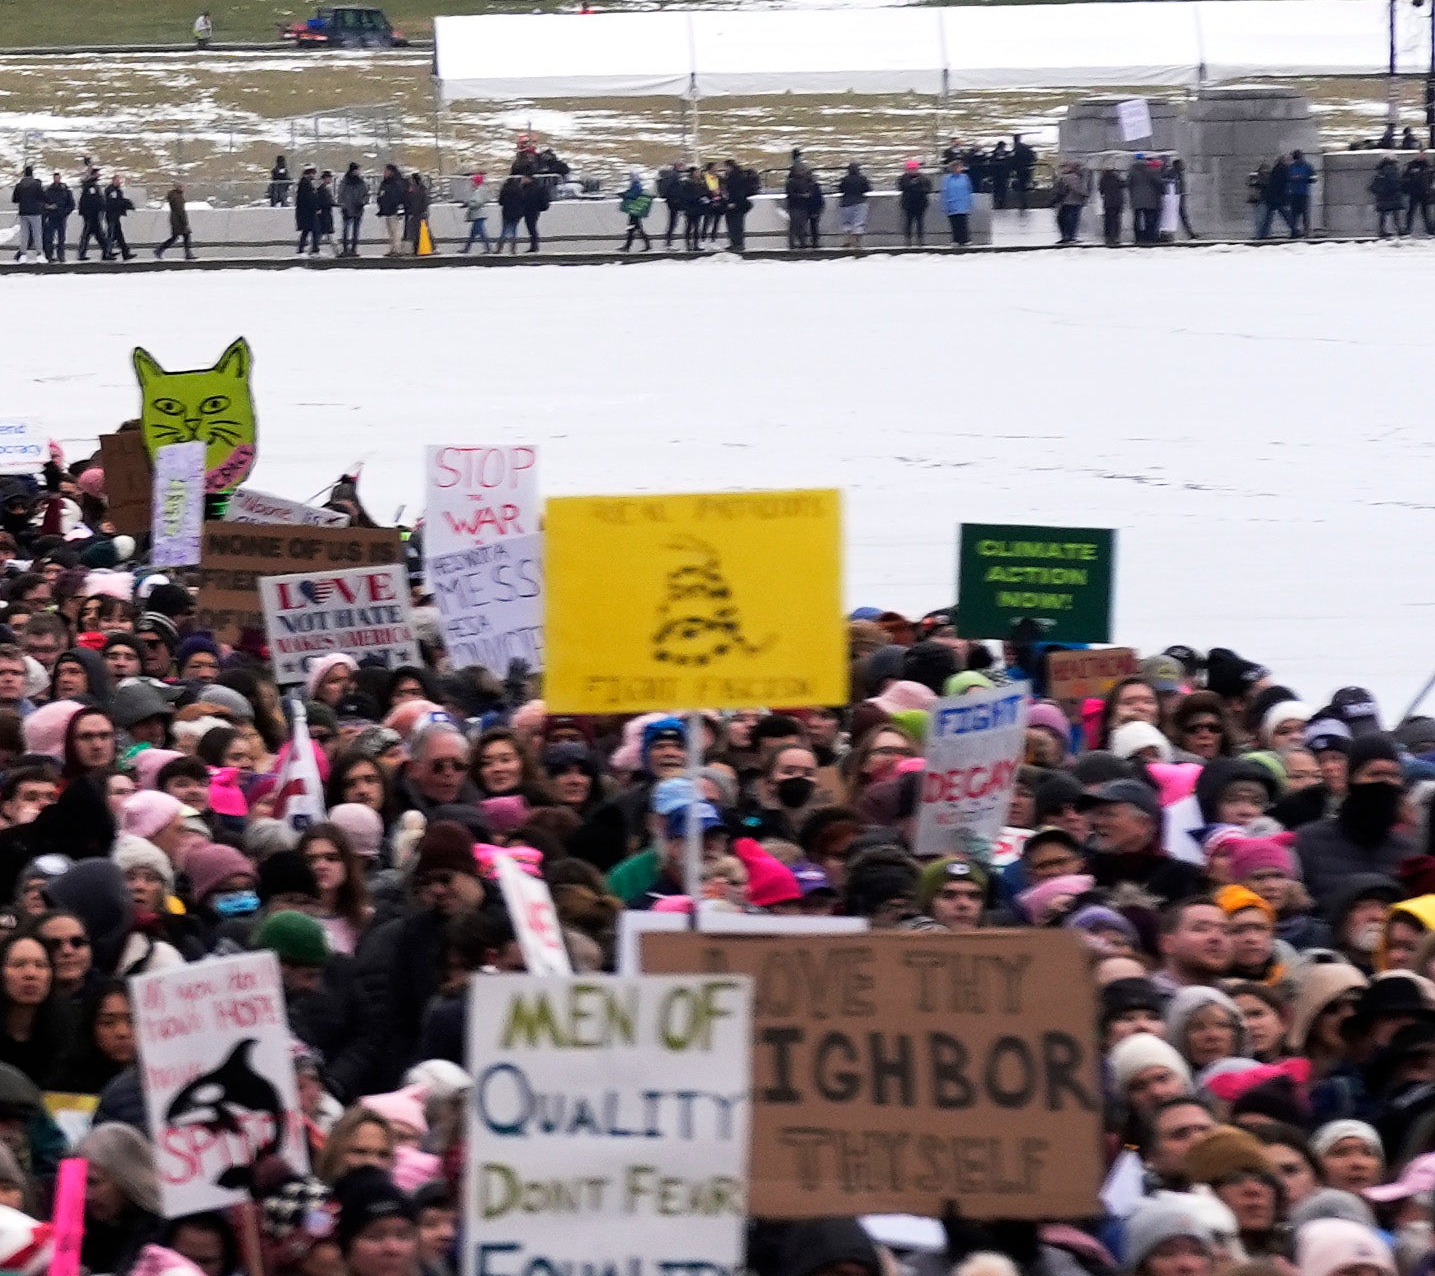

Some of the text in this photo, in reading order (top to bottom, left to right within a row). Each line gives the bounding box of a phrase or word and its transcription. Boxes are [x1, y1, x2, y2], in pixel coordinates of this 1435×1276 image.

[434, 447, 537, 489] STOP
[442, 503, 524, 536] WAR
[207, 533, 283, 557] NONE
[289, 536, 322, 561] OF
[331, 538, 362, 562] US
[976, 539, 1099, 560] CLIMATE
[984, 565, 1088, 586] ACTION
[998, 591, 1074, 611] NOW!
[276, 611, 334, 633] NOT
[337, 604, 402, 629] HATE
[501, 980, 739, 1053] MEN OF
[761, 1026, 1101, 1113] IGHBOR
[477, 1061, 746, 1141] QUALITY
[623, 1163, 743, 1218] FEAR
